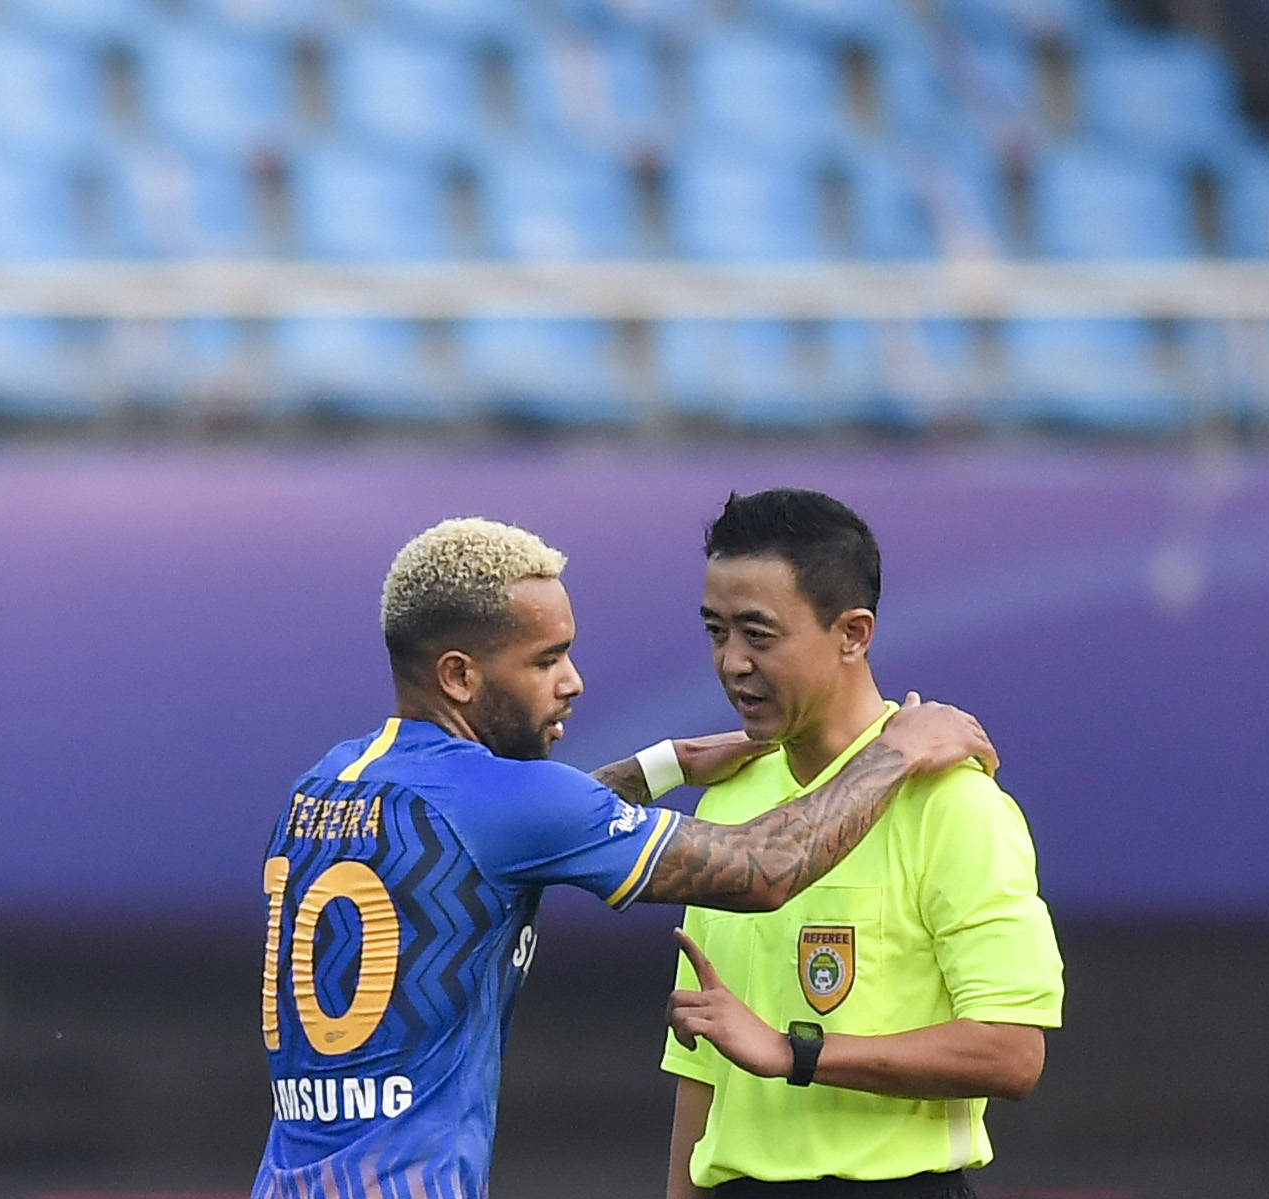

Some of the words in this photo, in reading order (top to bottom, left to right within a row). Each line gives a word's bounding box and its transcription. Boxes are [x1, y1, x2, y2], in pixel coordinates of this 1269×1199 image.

[286, 793, 381, 840] TEIXEIRA
[262, 856, 399, 1055] 10
[803, 933, 850, 944] REFEREE
